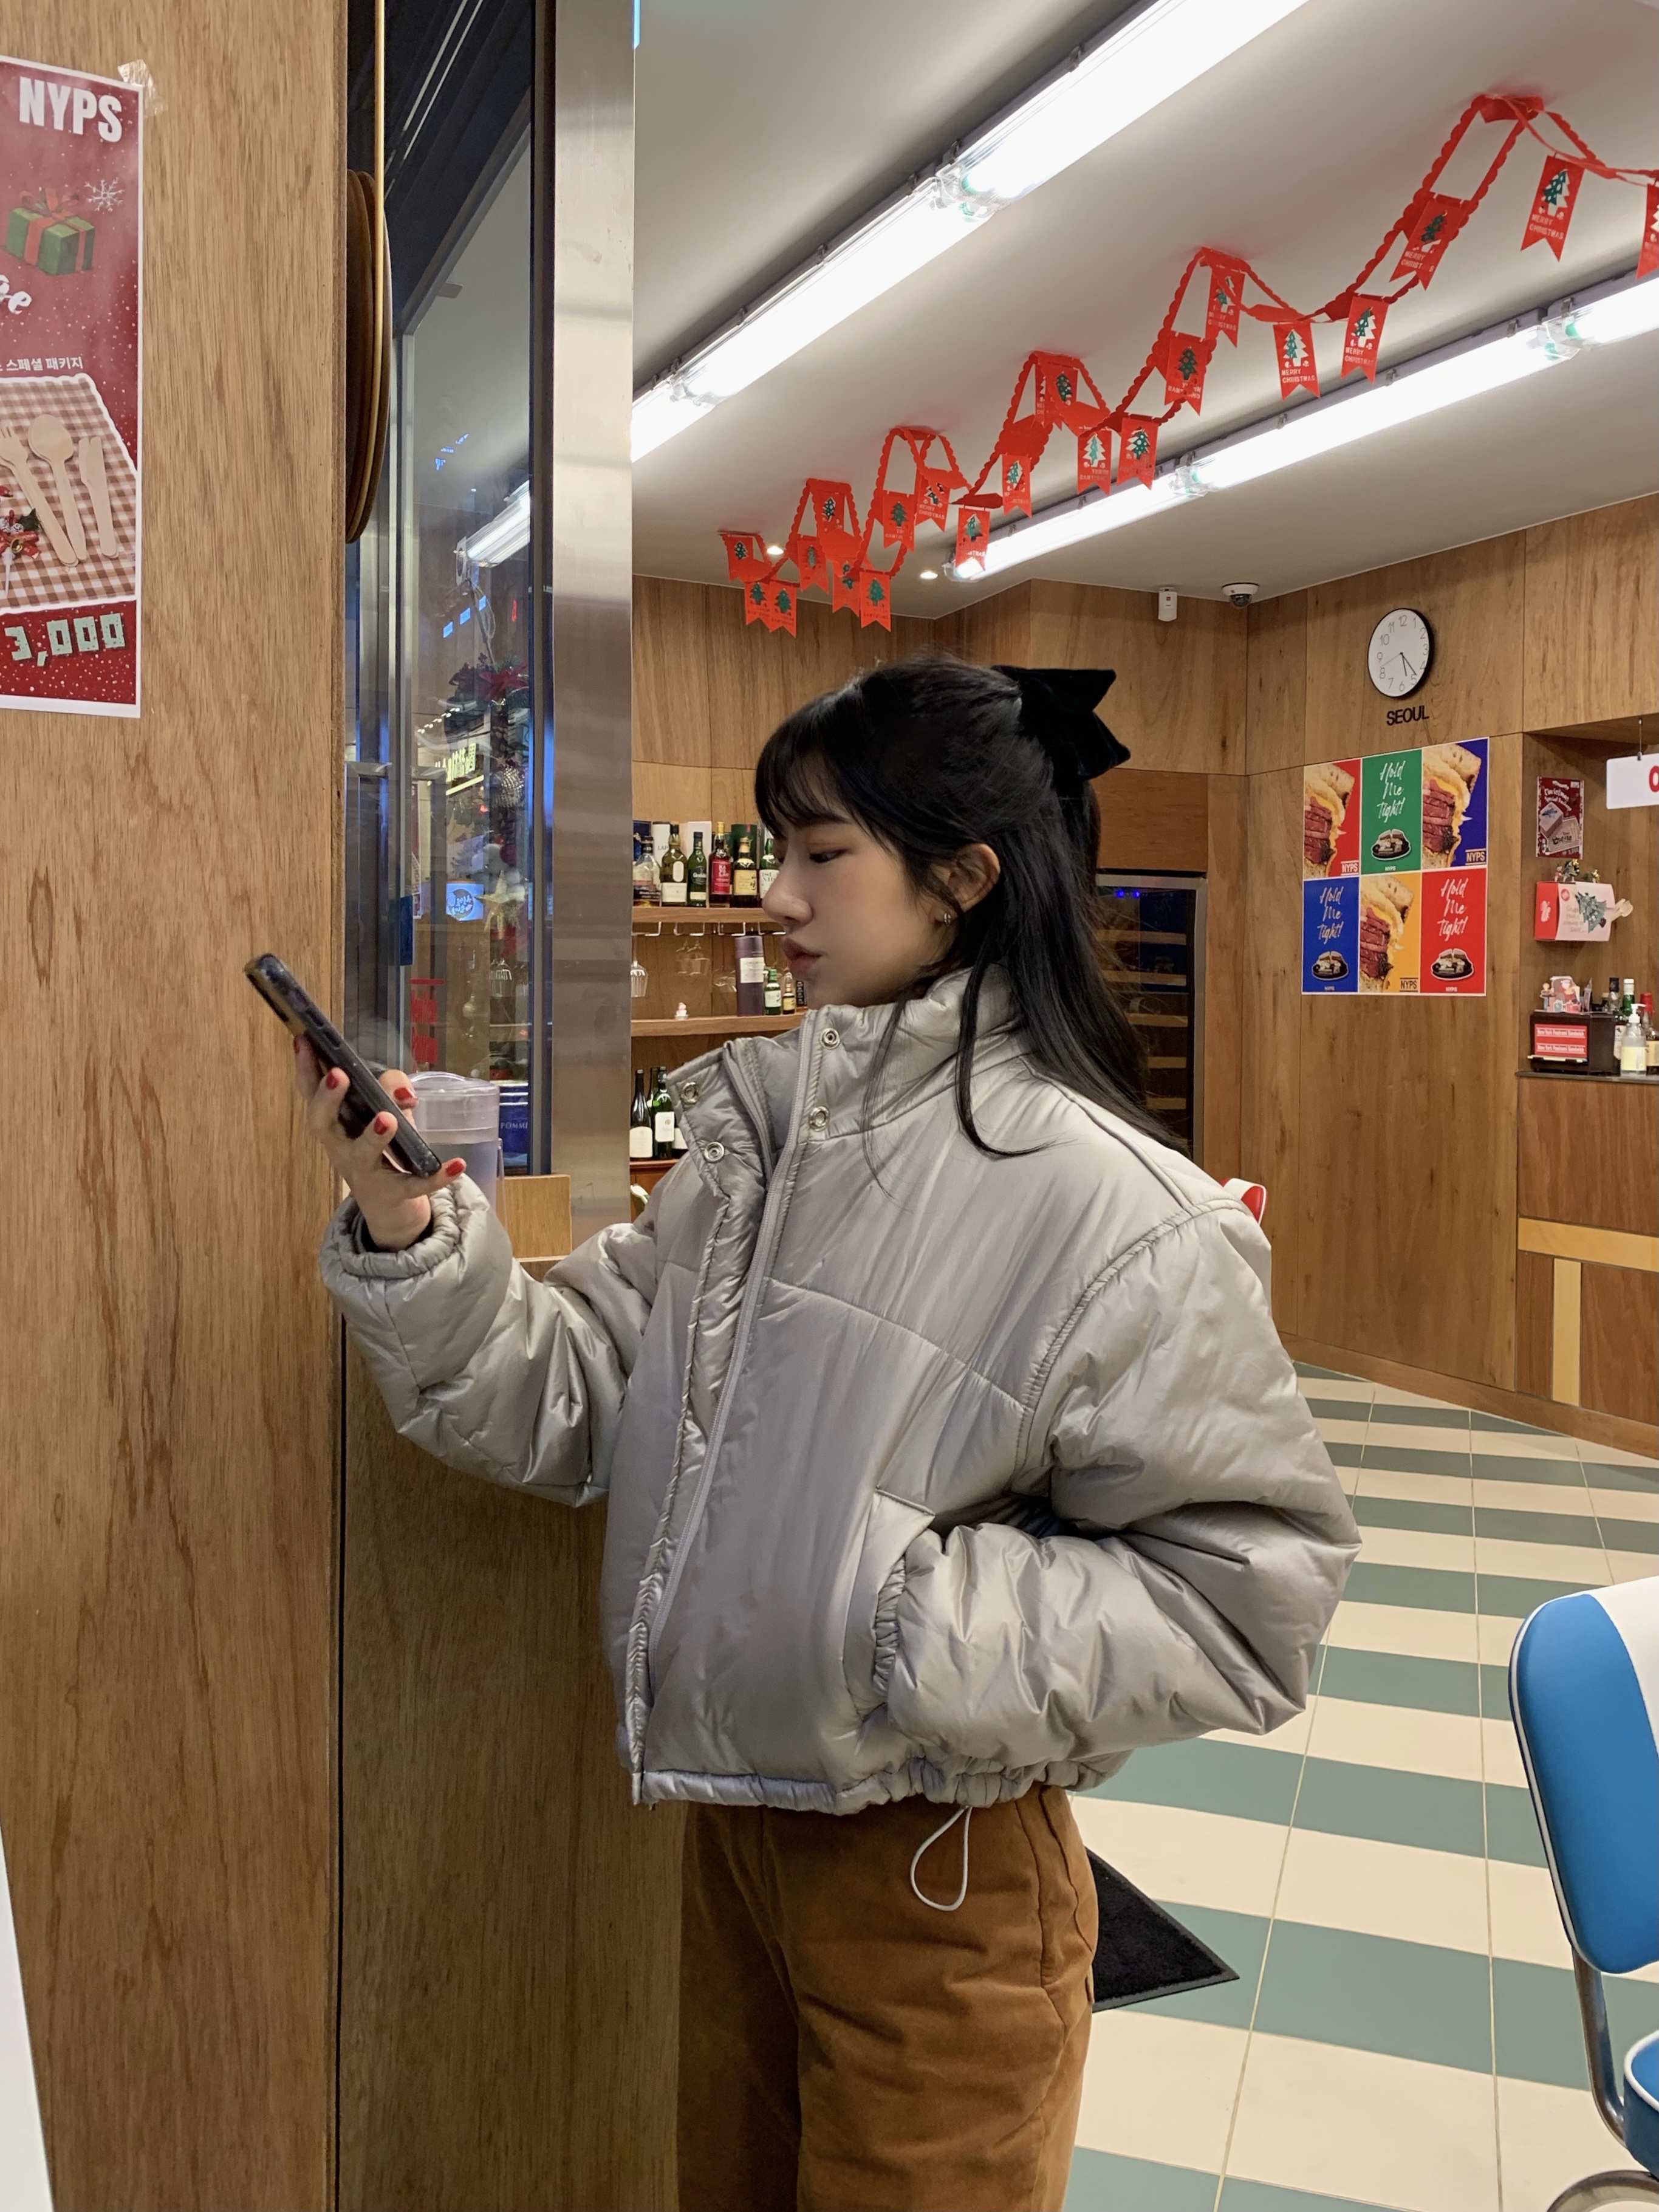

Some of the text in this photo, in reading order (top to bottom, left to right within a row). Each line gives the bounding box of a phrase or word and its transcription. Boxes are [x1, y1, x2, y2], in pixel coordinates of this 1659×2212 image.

[19, 77, 123, 142] NYPS
[1531, 214, 1553, 225] MERRY
[1529, 224, 1564, 239] CHRISTMAS
[1404, 251, 1426, 261] MERRY
[1401, 259, 1434, 272] CHRISTS
[1346, 347, 1364, 355] MERRY
[7, 358, 43, 371] 스페셜
[46, 357, 83, 370] 패키지
[1282, 375, 1315, 383] CHRISTMAS
[1388, 621, 1395, 633] 11
[1398, 615, 1408, 627] 12
[1413, 617, 1417, 628] 1
[5, 612, 127, 667] 3,000
[1420, 627, 1426, 640] 2
[1380, 634, 1390, 646] 10
[1423, 644, 1428, 655] 3
[1377, 652, 1383, 663] 9
[1420, 661, 1426, 671] 4
[1380, 668, 1386, 679] 8
[1388, 678, 1394, 690] 7
[1399, 680, 1405, 692] 6
[1411, 674, 1417, 686] 5
[1386, 705, 1429, 726] SEOUL
[1380, 760, 1406, 781] Hold
[1383, 782, 1404, 799] Me
[1466, 851, 1485, 862] NYPS
[1342, 863, 1358, 873] NYPS
[1441, 877, 1468, 900] Hold
[1320, 886, 1344, 906] Hold
[1323, 906, 1341, 921] Me
[1444, 900, 1467, 916] Me
[1400, 979, 1418, 990] NYPS
